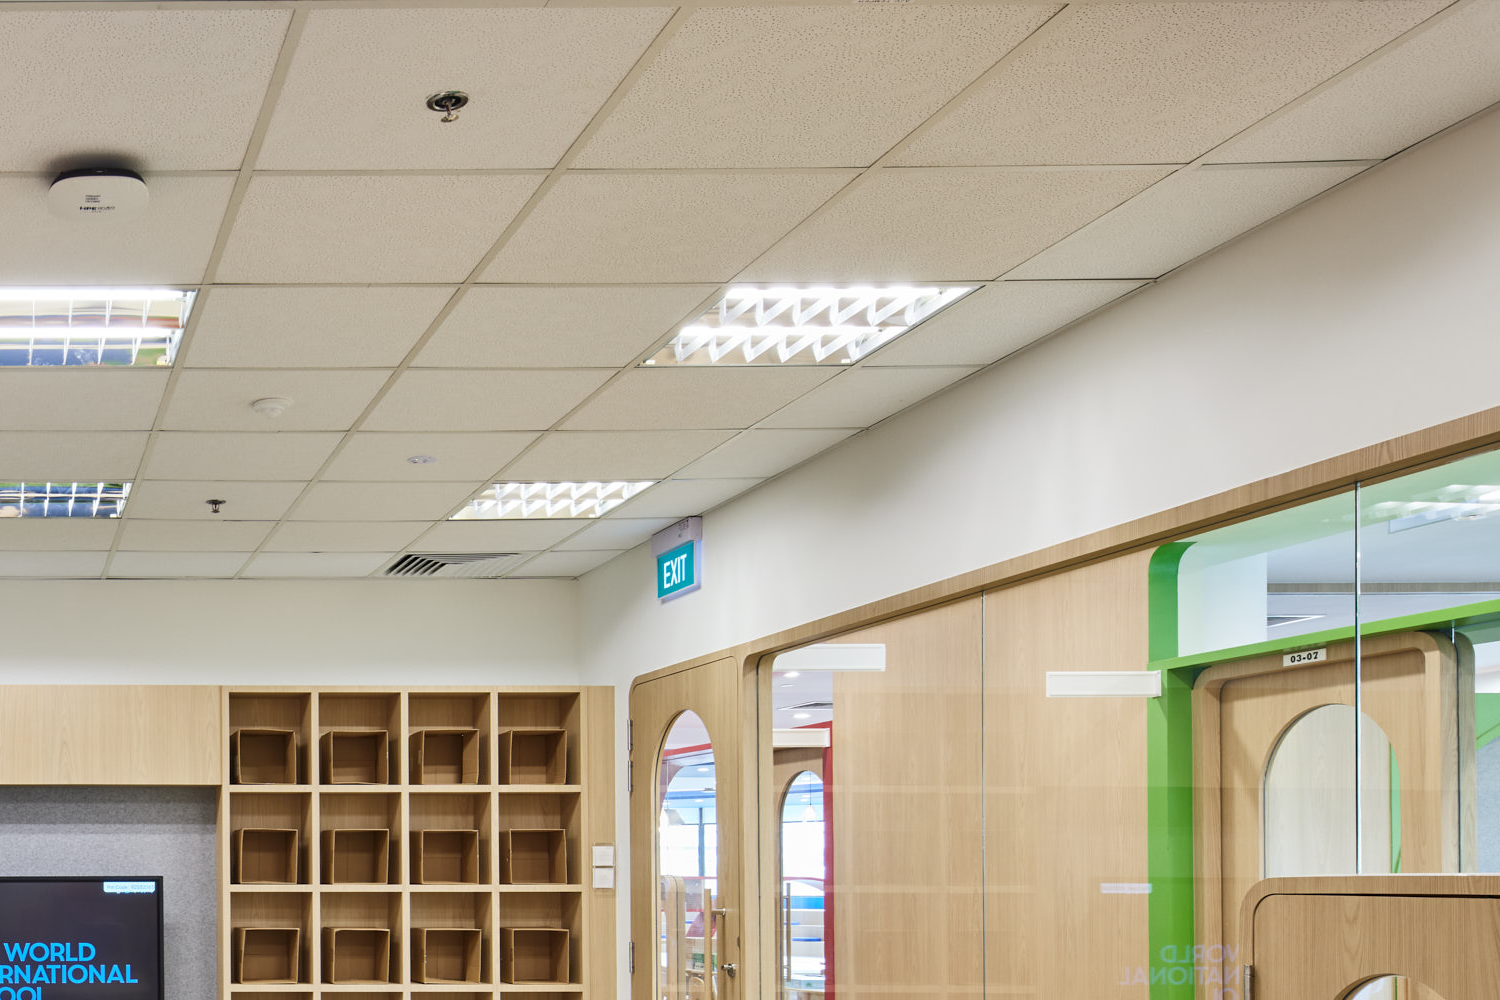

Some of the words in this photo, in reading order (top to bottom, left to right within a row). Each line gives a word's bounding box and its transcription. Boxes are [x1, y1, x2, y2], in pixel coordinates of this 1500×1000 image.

[663, 553, 687, 589] EXIT
[1290, 651, 1319, 663] 03-07
[3, 942, 96, 962] WORLD
